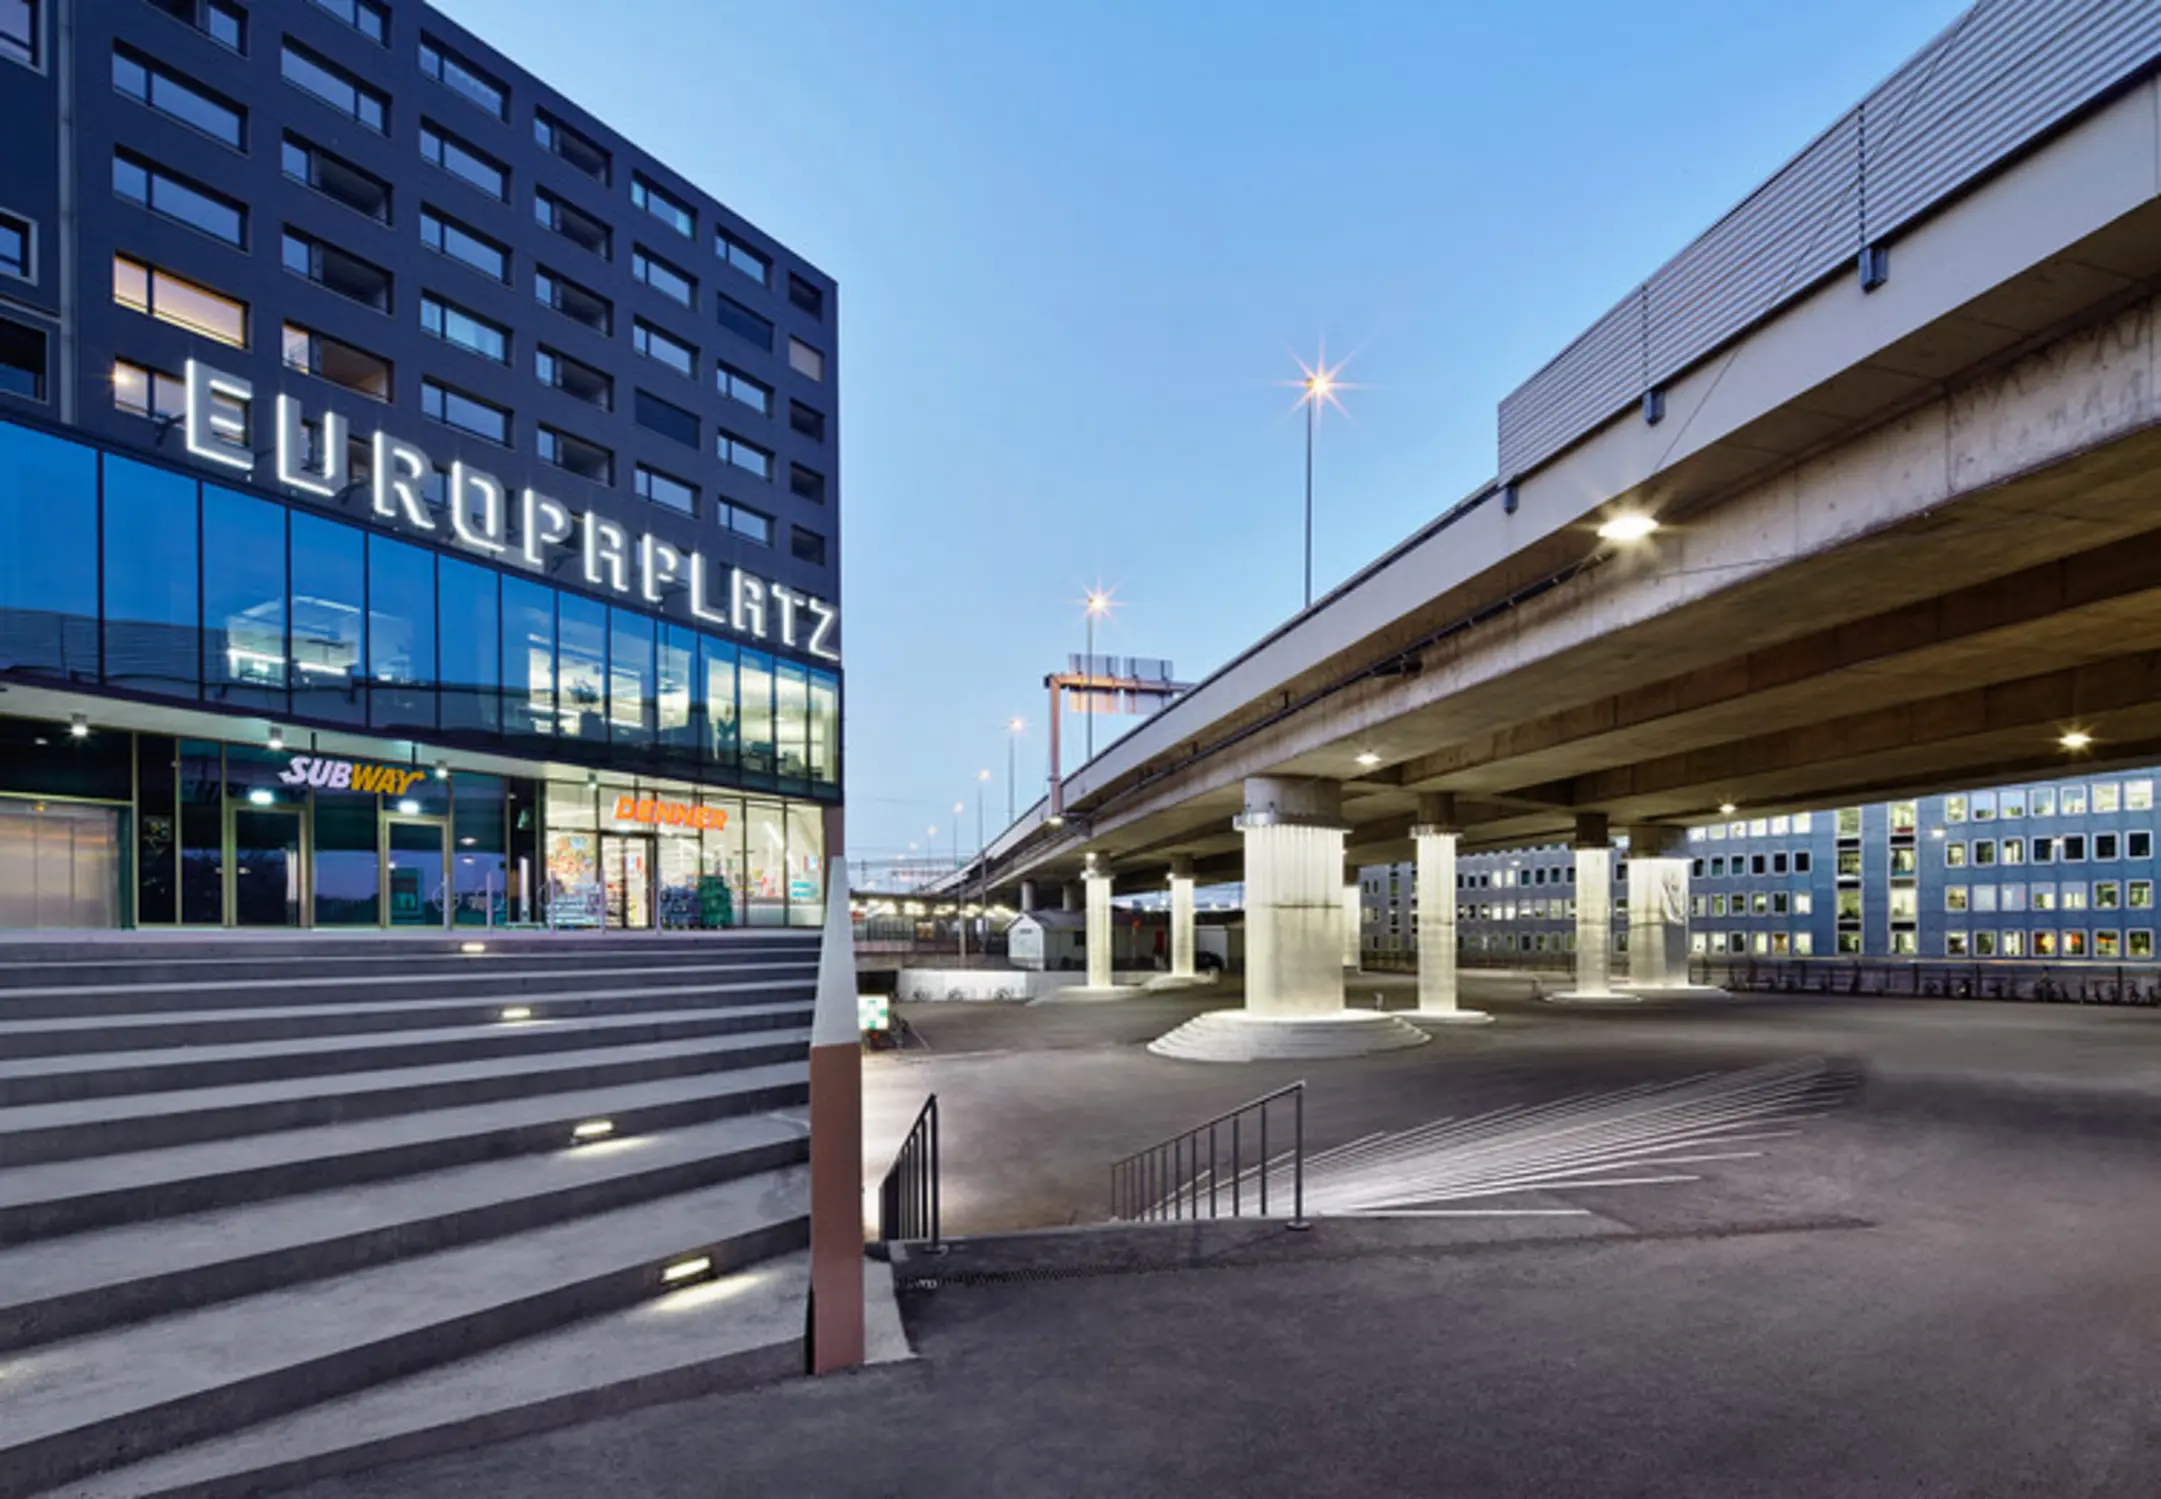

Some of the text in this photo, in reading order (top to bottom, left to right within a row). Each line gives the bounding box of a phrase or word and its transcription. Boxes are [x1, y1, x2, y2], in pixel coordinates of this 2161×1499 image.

[185, 358, 840, 662] EUROPAPLATZ
[278, 755, 425, 796] SUBWAY
[614, 795, 729, 831] DENNER
